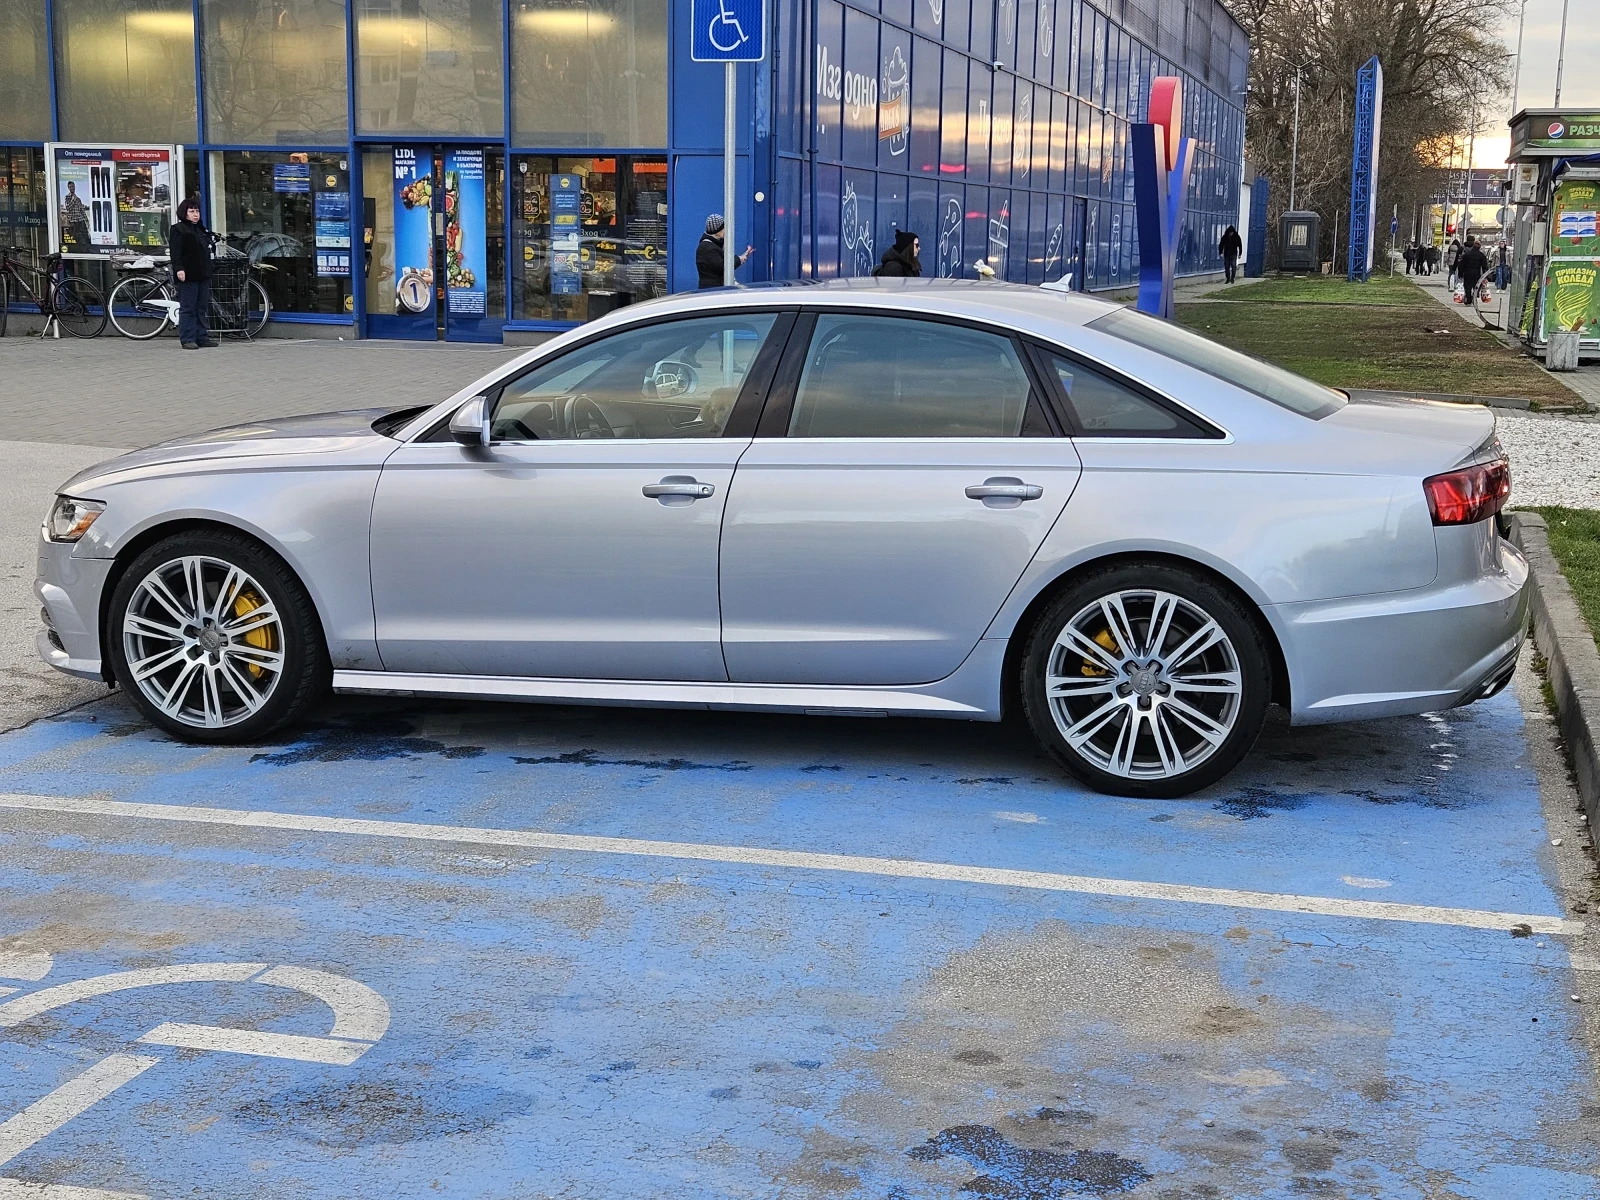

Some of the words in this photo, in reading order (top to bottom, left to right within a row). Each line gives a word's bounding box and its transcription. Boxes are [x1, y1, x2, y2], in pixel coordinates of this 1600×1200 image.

[394, 148, 416, 159] LIDL
[1555, 267, 1597, 277] ПРИКАЗНА
[1557, 274, 1594, 285] КОЛЕДА
